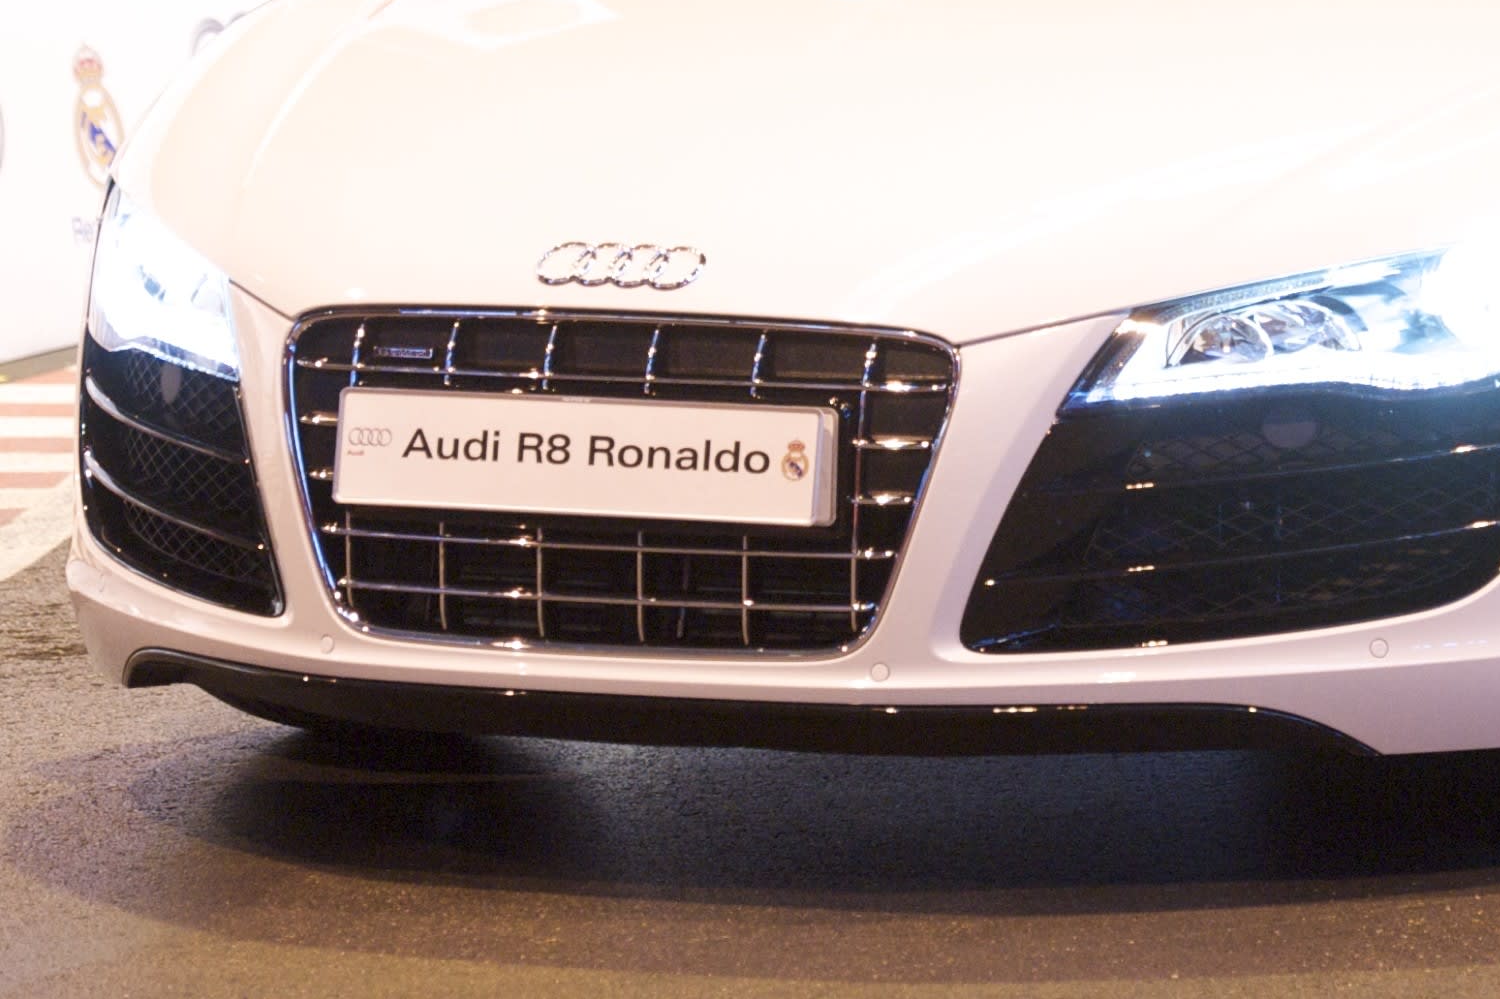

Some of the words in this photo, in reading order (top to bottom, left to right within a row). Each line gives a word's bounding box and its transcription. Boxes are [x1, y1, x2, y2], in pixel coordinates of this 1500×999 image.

[402, 428, 500, 462] Audi
[518, 432, 571, 464] R8
[588, 435, 770, 474] Ronaldo
